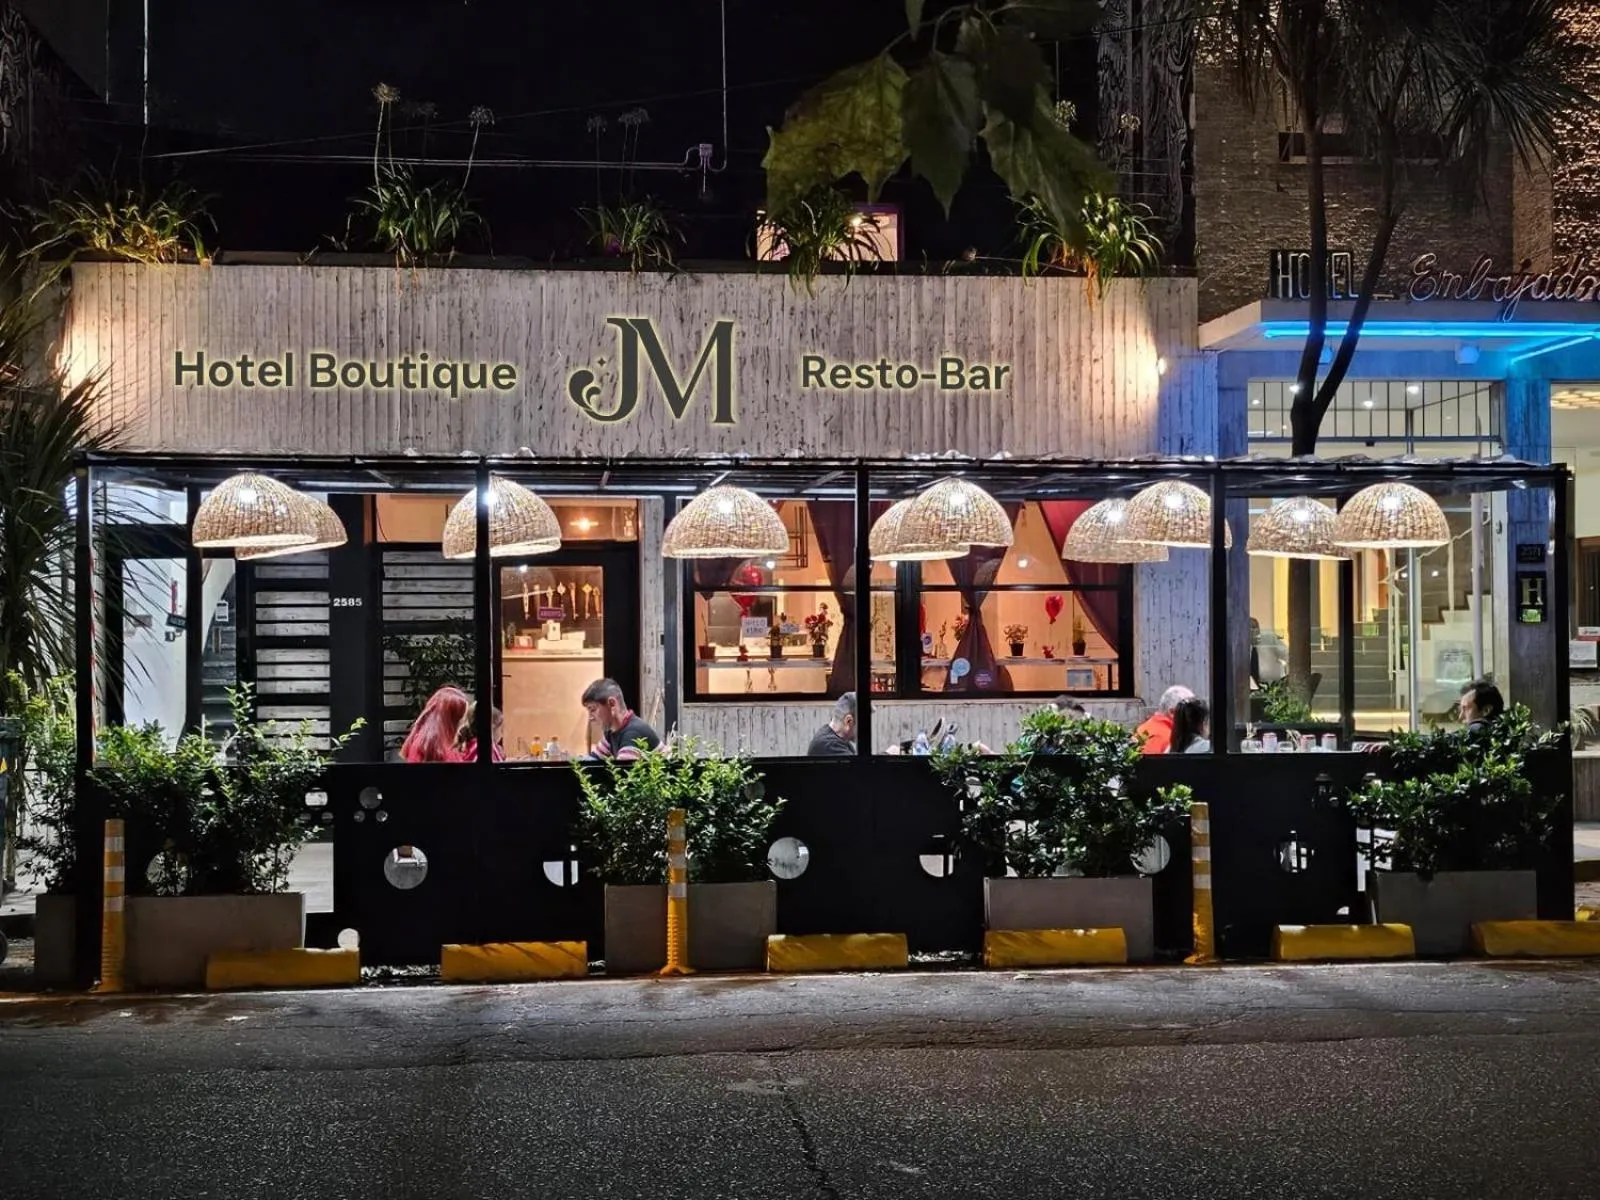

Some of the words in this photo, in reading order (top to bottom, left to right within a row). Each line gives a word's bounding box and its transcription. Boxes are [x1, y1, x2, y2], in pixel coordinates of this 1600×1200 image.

[1277, 251, 1359, 299] HOEL
[1409, 252, 1600, 322] Embajado
[174, 351, 293, 388] Hotel
[309, 352, 517, 399] Boutique
[568, 317, 736, 424] JM
[802, 355, 1011, 390] Resto-Bar
[333, 597, 363, 607] 2585
